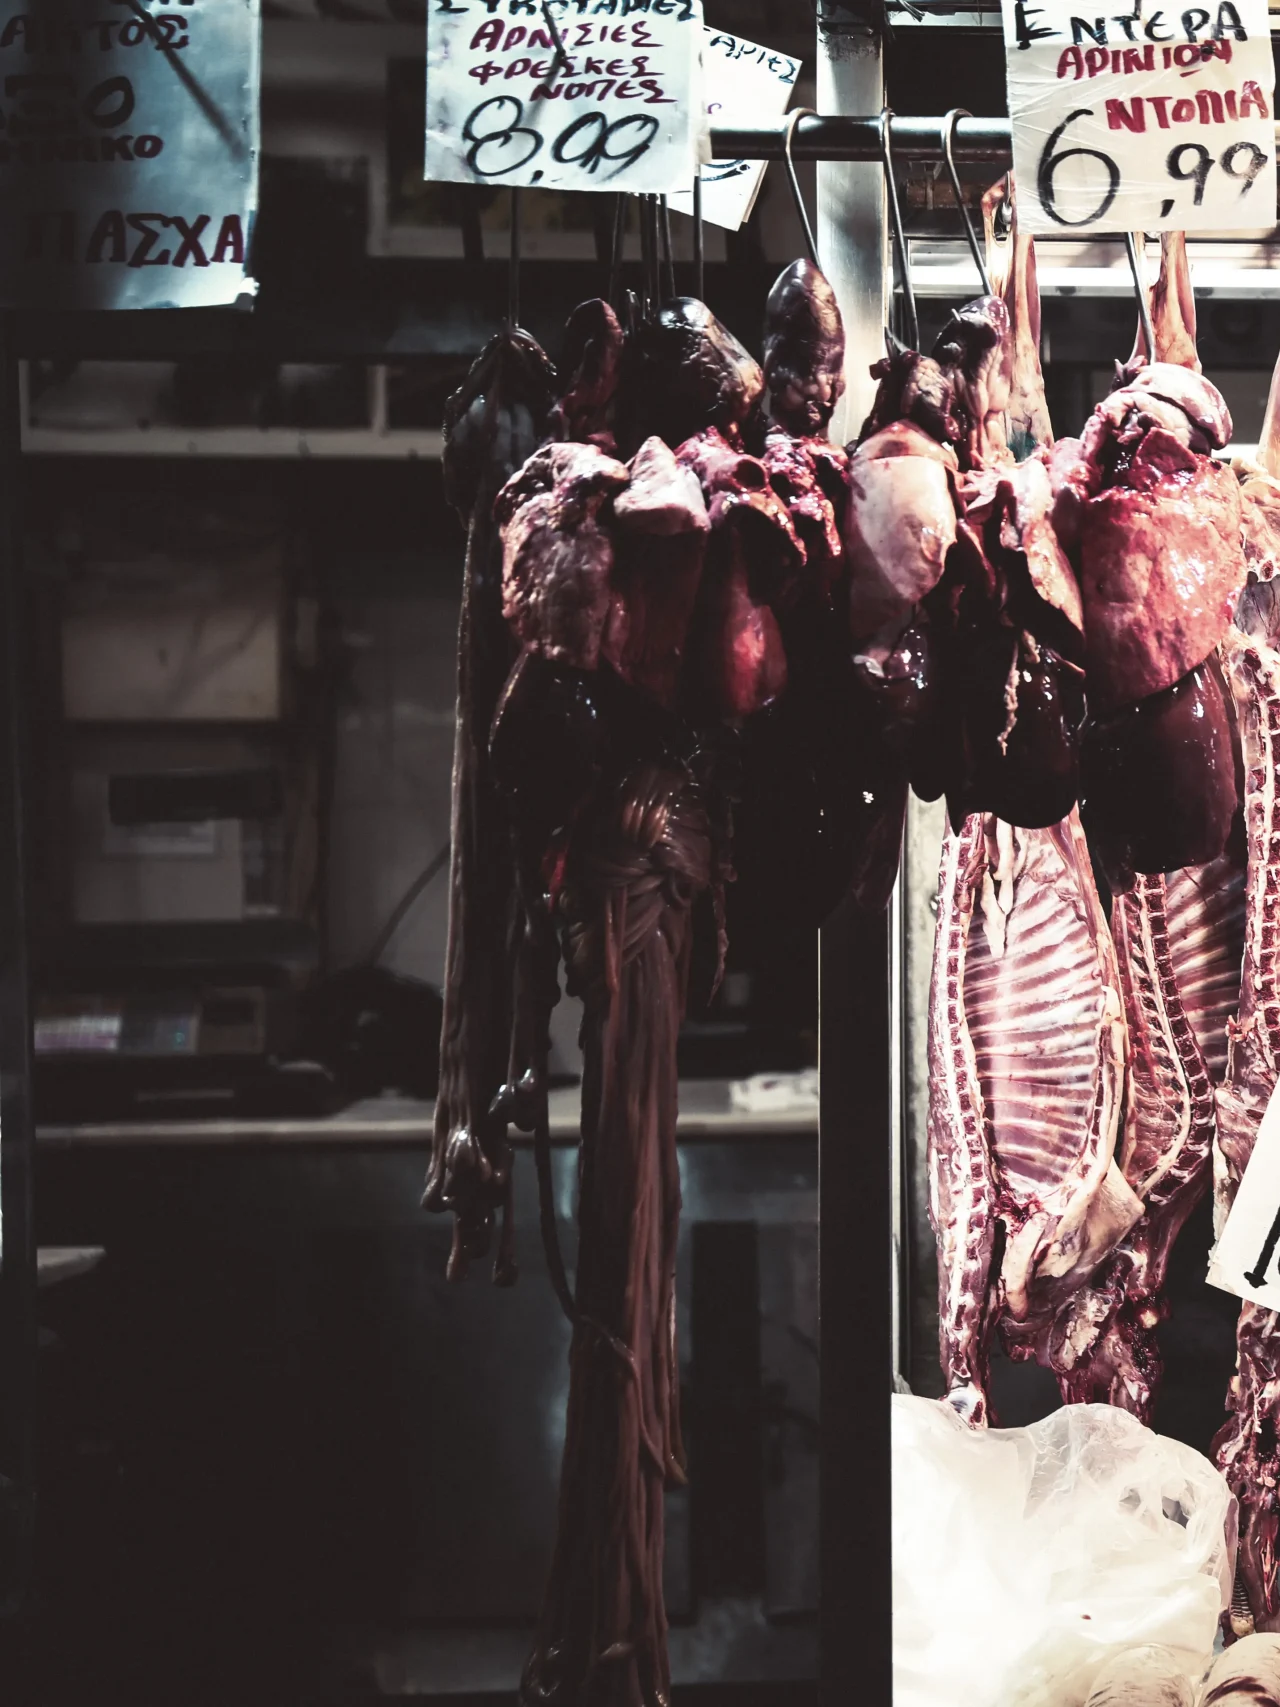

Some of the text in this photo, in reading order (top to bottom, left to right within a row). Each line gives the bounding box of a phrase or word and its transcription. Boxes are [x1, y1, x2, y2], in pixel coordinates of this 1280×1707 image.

[1014, 0, 1248, 49] ΕΝΤΕΡΑ
[468, 55, 665, 86] ΦΡΕΣΚΕΣ
[529, 79, 678, 104] ΝΟΠΕΣ
[1105, 80, 1269, 133] ΝΤΟΠΙΑ
